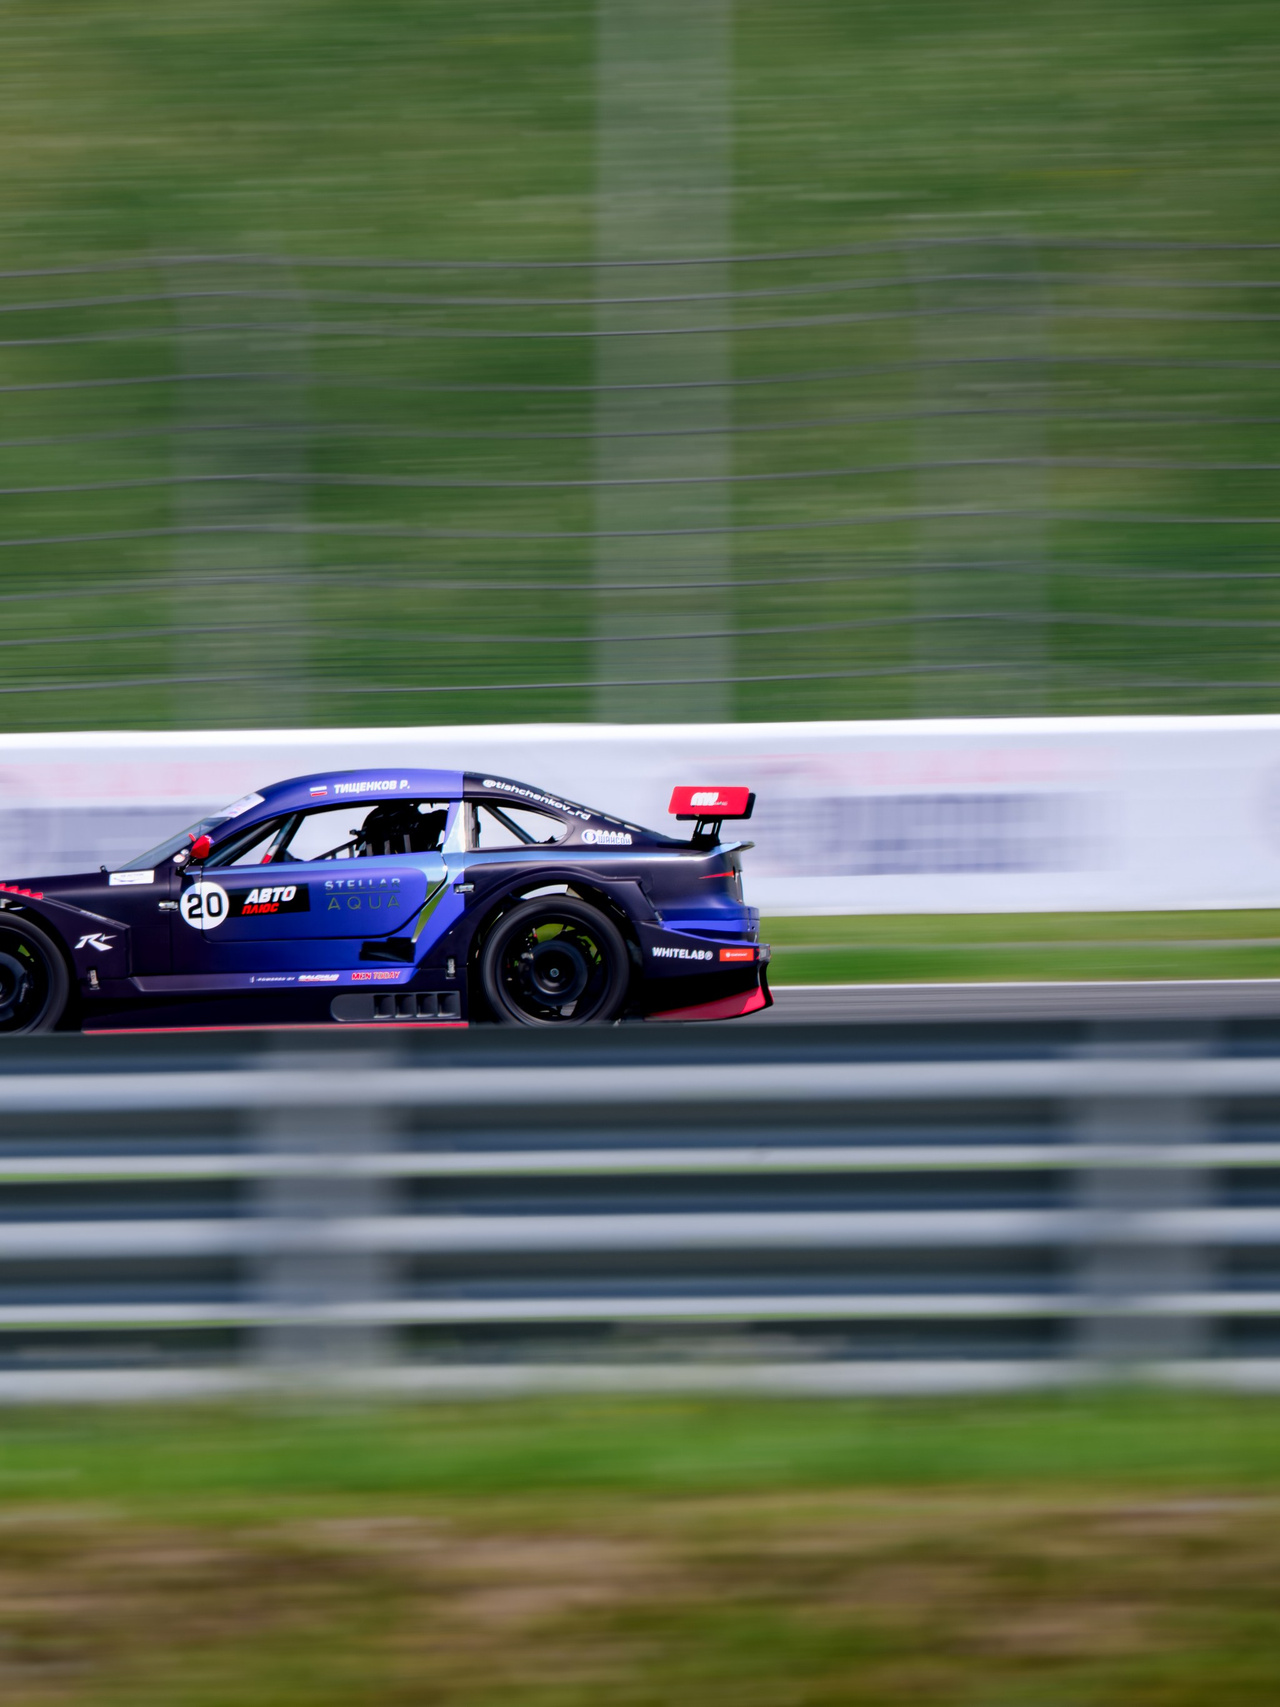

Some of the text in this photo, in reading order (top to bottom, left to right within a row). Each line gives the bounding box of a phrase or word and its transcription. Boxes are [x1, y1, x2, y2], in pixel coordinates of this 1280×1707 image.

[333, 779, 410, 794] ТИЩЕНКОВ Р.
[482, 779, 591, 821] @tishchenkov_rd
[324, 878, 401, 890] STELLAR
[244, 886, 297, 905] АВТО
[327, 895, 400, 911] AQUA
[187, 892, 224, 919] 20
[241, 902, 280, 915] ПЛЮС
[351, 971, 401, 981] MEN TODAY
